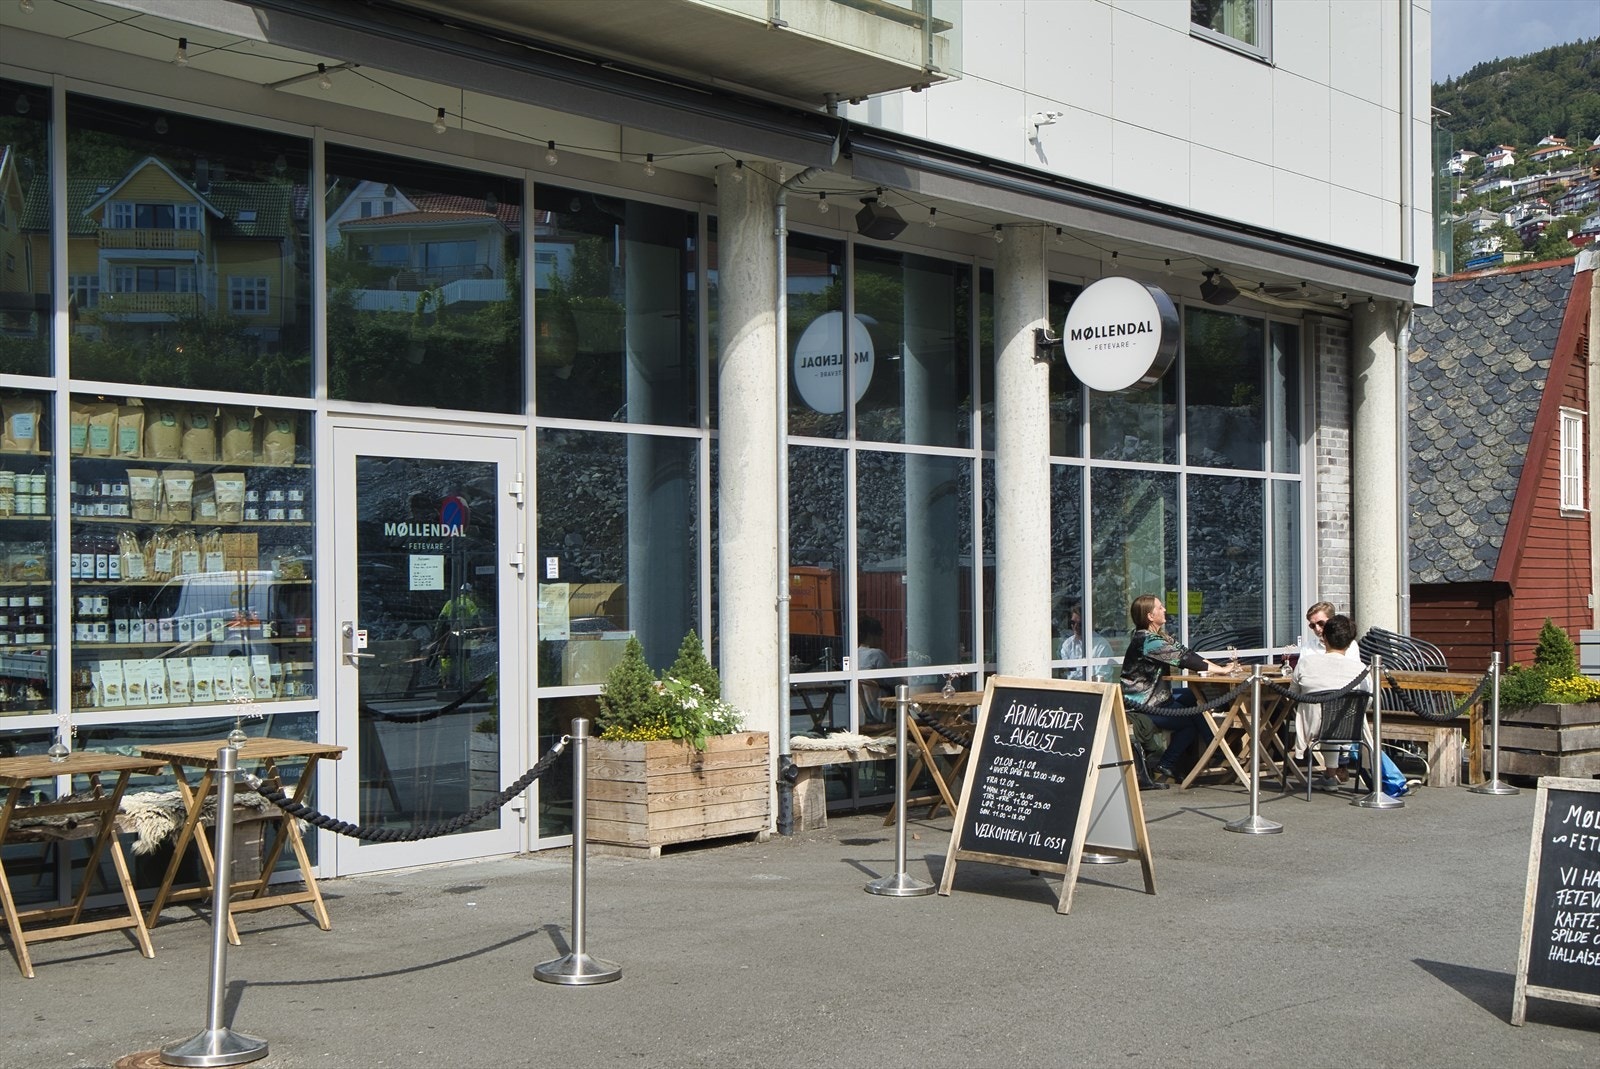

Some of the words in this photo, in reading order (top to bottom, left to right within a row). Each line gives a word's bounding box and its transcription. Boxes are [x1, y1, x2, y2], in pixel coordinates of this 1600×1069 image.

[1071, 320, 1153, 341] MØLLENDAL
[1094, 341, 1130, 351] FETEVARE
[384, 522, 467, 537] MØLLENDAL
[408, 542, 444, 550] FETEVARE
[1003, 699, 1084, 731] ÅPNINGSTIDER
[1009, 727, 1063, 750] AUGUST
[986, 775, 999, 784] FRA
[1009, 767, 1022, 776] DAG
[975, 822, 1027, 844] VELKOMMEN
[1028, 831, 1041, 847] TIL
[1043, 836, 1067, 855] OSS!
[1569, 833, 1600, 853] FET
[1560, 866, 1578, 886] VI
[1554, 910, 1600, 930] KAFFE,
[1550, 928, 1591, 943] SPILDE
[1548, 945, 1600, 966] HALLAISE
